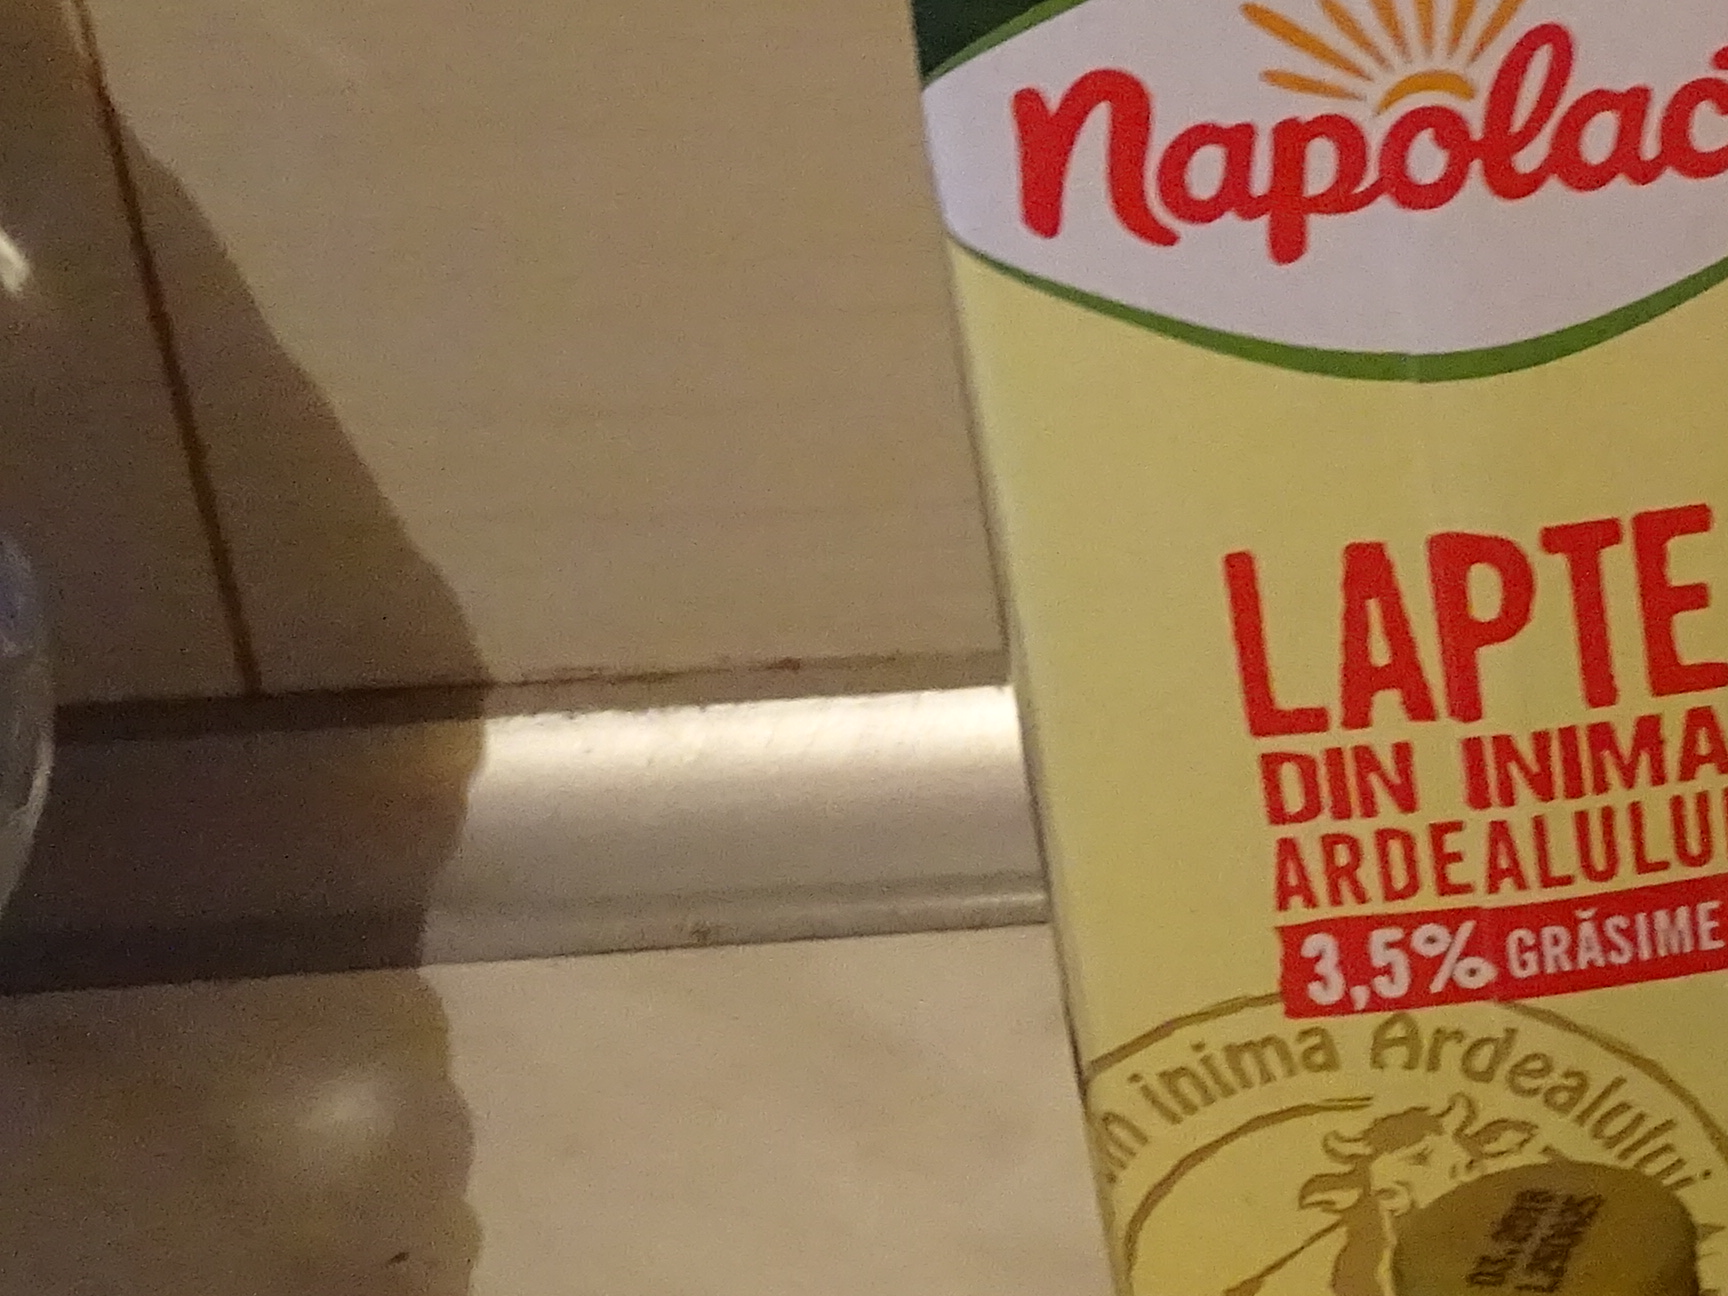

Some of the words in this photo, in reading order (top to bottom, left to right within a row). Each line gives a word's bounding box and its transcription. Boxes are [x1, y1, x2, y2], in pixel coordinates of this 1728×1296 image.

[1258, 742, 1416, 827] DIN
[1301, 920, 1498, 1011] 3,5%
[1505, 900, 1726, 980] GRĂSIME
[1127, 1024, 1340, 1125] inima
[1371, 1011, 1713, 1190] Ardealului
